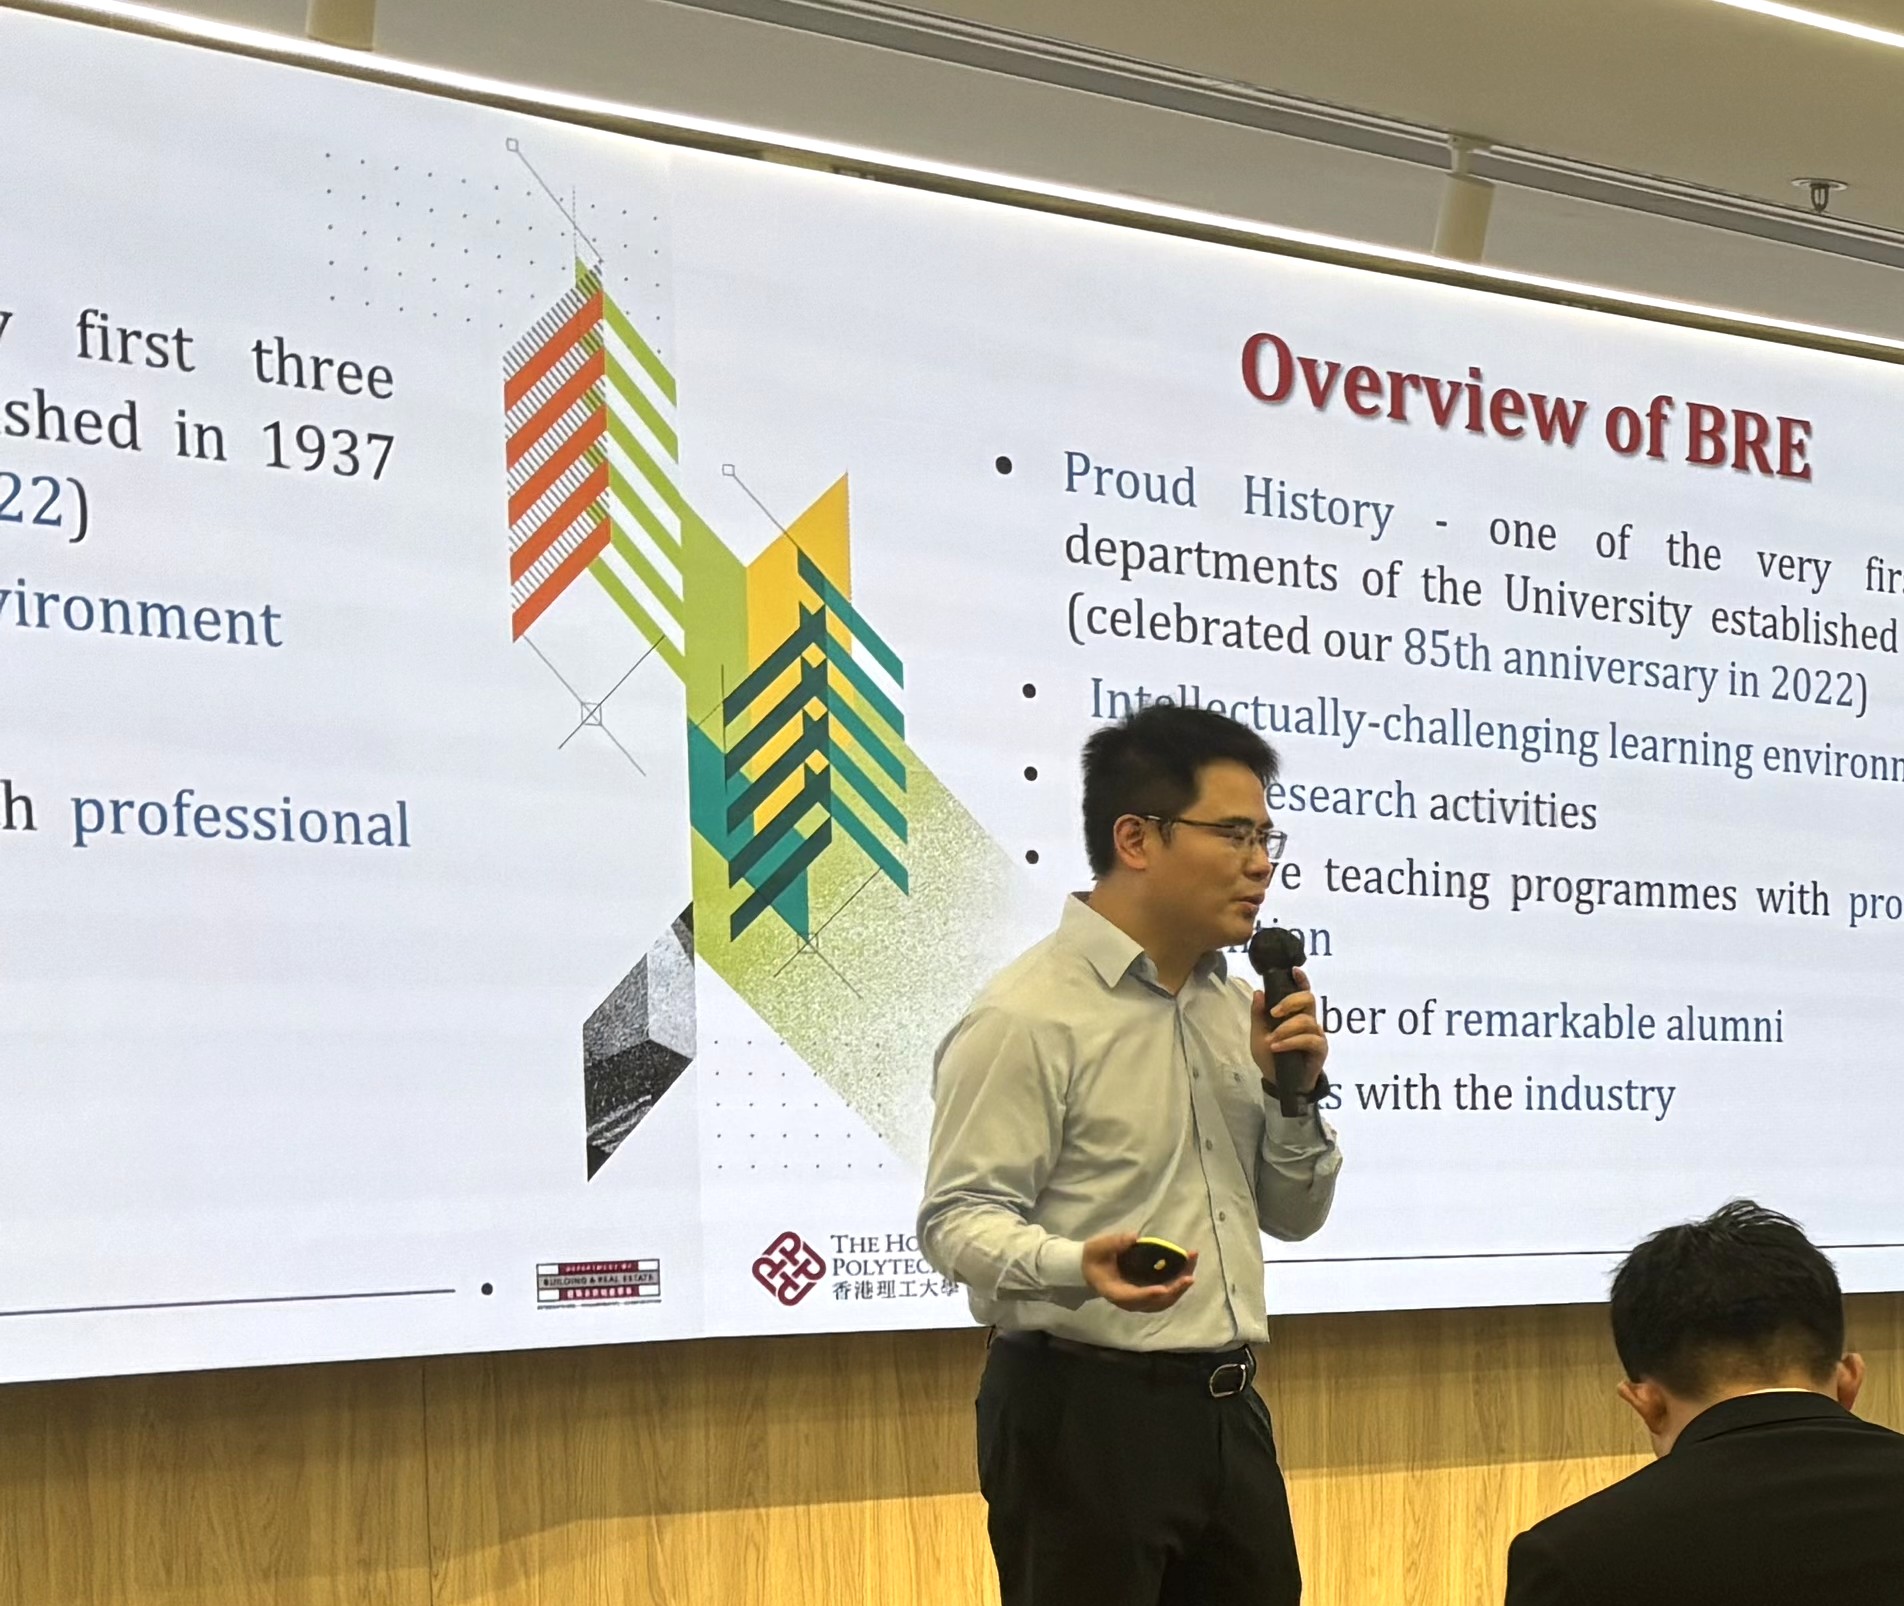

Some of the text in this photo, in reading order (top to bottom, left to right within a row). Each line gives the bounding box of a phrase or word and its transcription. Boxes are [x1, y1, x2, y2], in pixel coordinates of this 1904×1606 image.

[76, 308, 394, 400] first three
[4, 387, 395, 481] shed in 1937
[1241, 332, 1813, 483] Overview of BRE
[1064, 450, 1197, 508] Proud
[1244, 474, 1395, 542] History
[1489, 518, 1557, 551] one
[1596, 523, 1634, 561] of
[1665, 530, 1722, 571] the
[1756, 551, 1833, 595] very
[1065, 522, 1338, 592] departments
[1362, 559, 1404, 599] of
[1421, 564, 1482, 607] the
[1504, 573, 1693, 640] University
[1711, 604, 1898, 654] established
[1068, 591, 1867, 719] (celebrated our 85th anniversary in 2022)
[1092, 678, 1600, 767] Intllectually-challenging
[1609, 721, 1754, 780] learning
[70, 788, 411, 848] professional
[1267, 780, 1597, 830] esearch activities
[1324, 857, 1491, 911] teaching
[1511, 873, 1737, 915] programmes
[1755, 880, 1830, 917] with
[1321, 996, 1783, 1043] ber of remarkable alumni
[1354, 1072, 1442, 1111] with
[1453, 1072, 1513, 1111] the
[1525, 1074, 1677, 1122] industry
[830, 1234, 920, 1254] THE HO
[832, 1257, 934, 1277] POLYTEC
